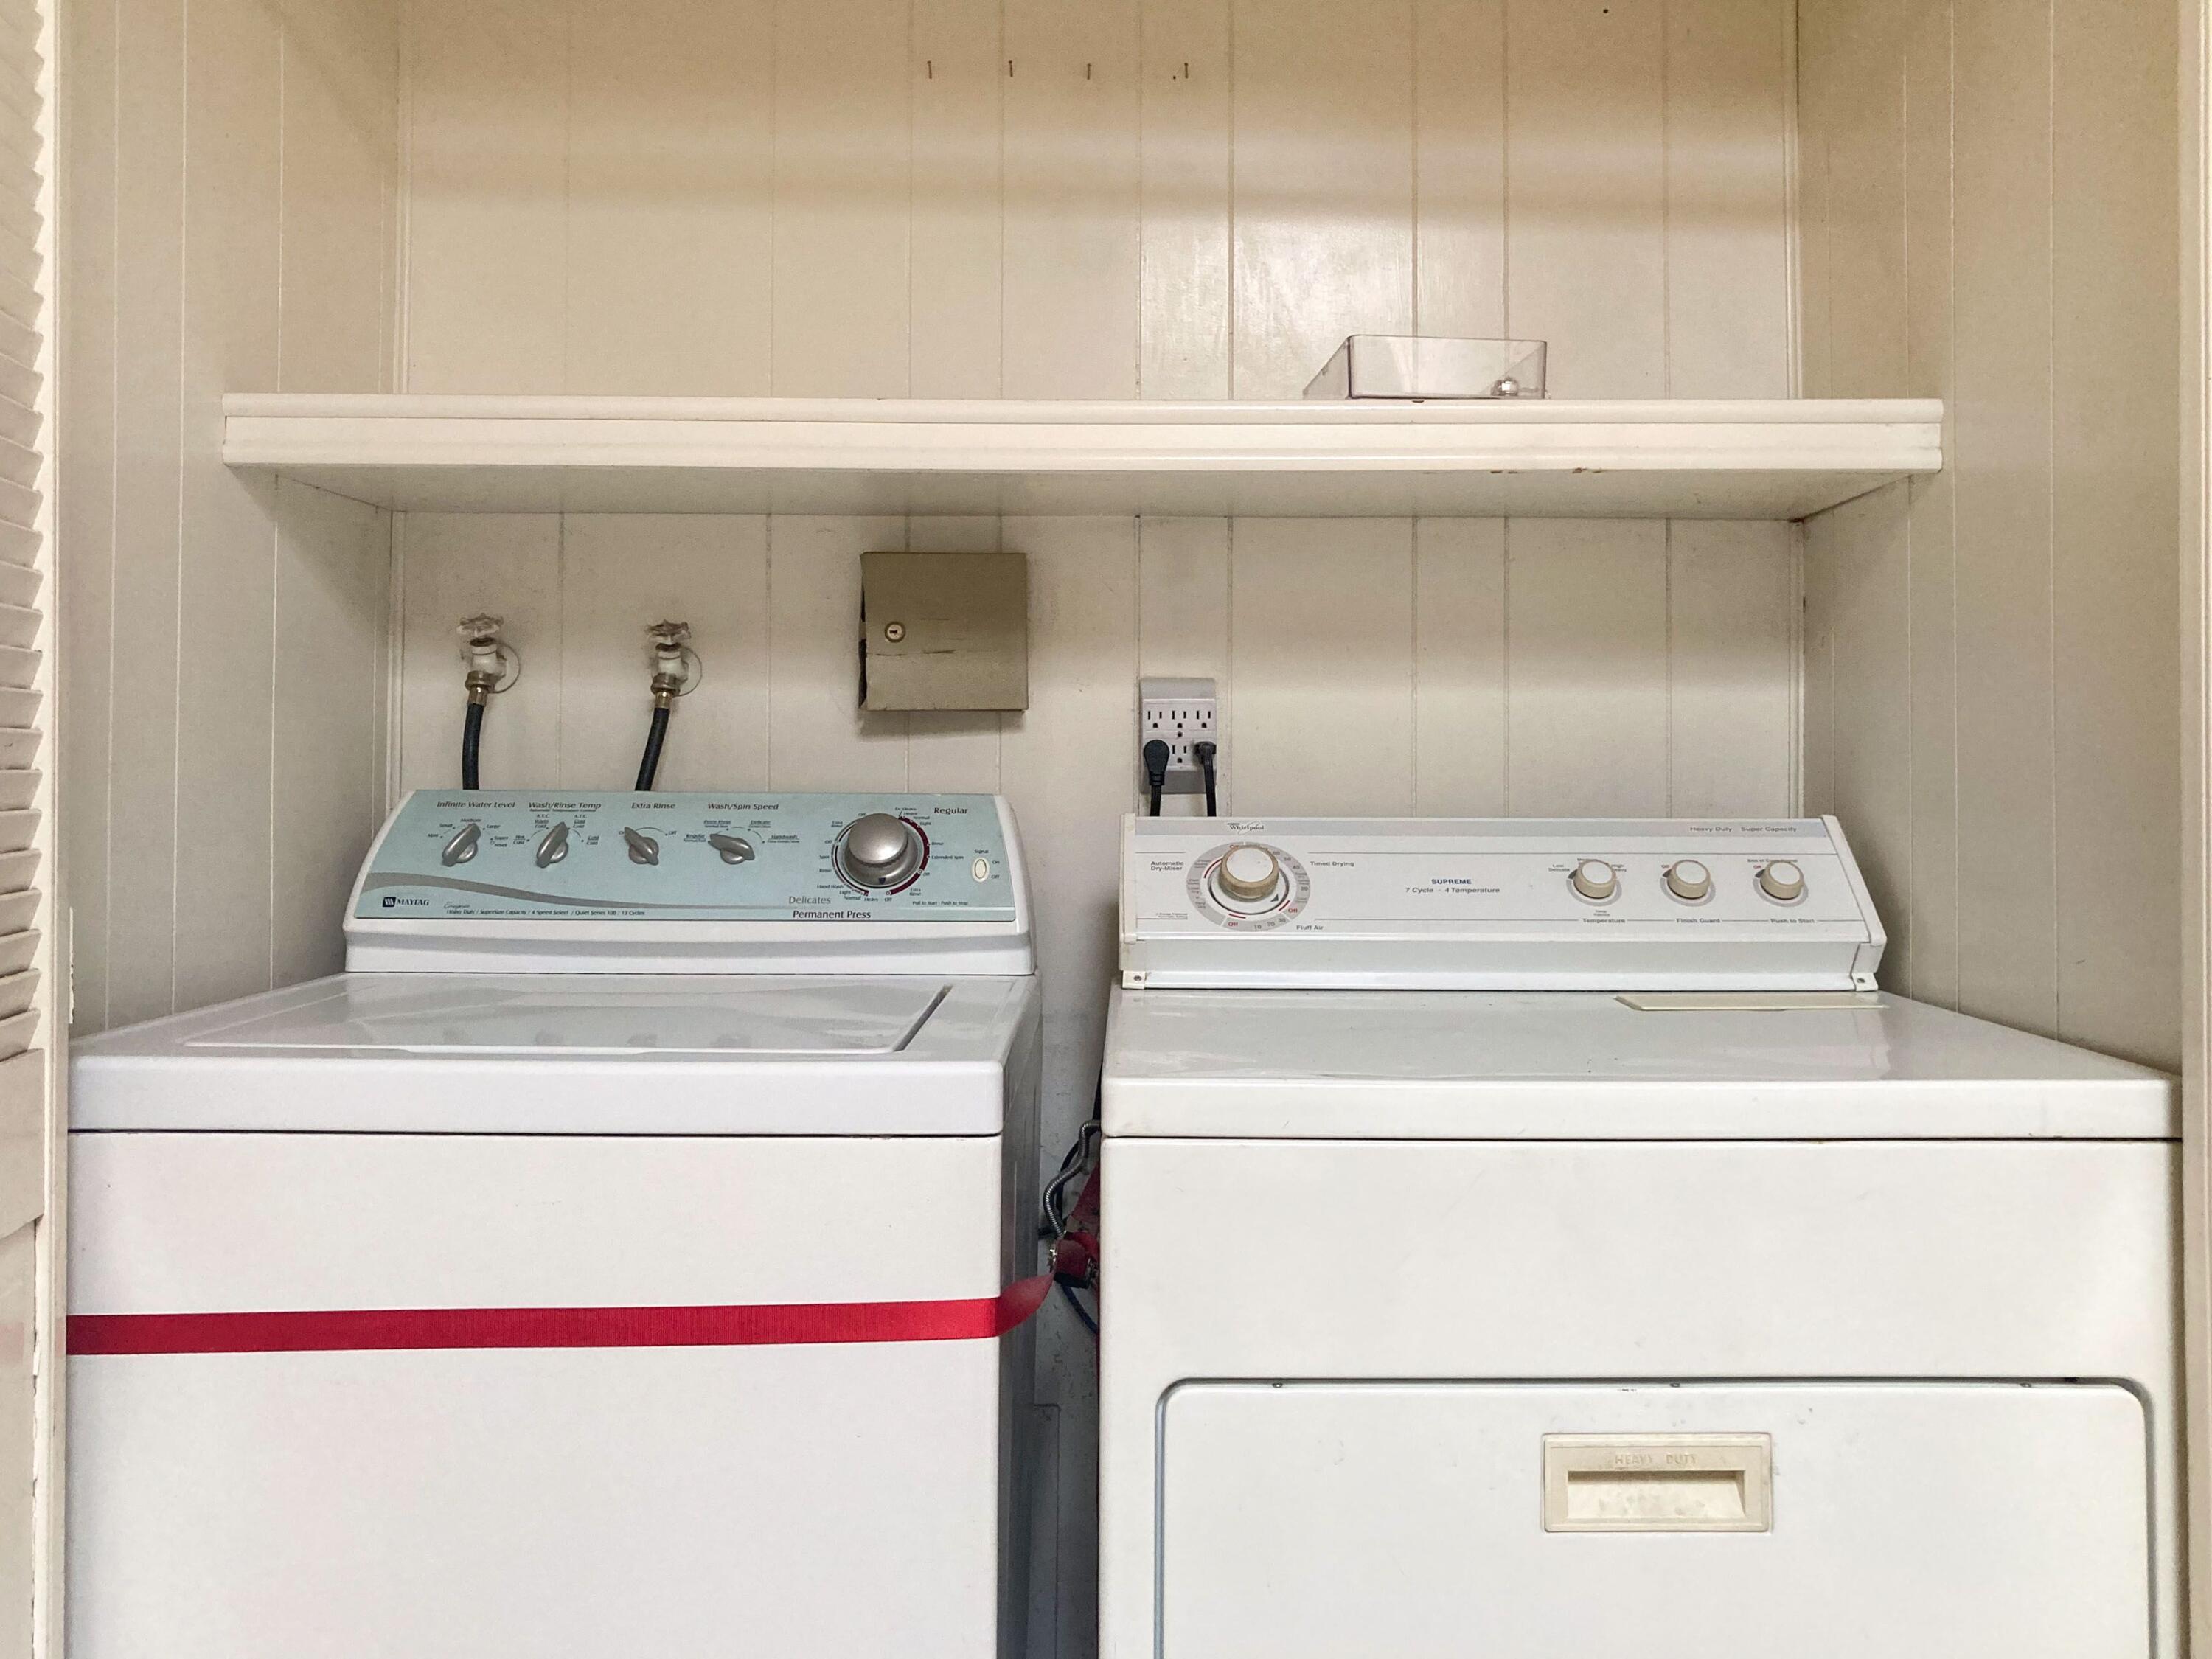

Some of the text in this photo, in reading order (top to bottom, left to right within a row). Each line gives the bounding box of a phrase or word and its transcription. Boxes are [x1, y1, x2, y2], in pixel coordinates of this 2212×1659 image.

[437, 801, 466, 809] Infinite
[579, 802, 602, 810] Temp
[753, 803, 779, 811] Speed
[1229, 824, 1264, 832] Whirlpool
[397, 898, 430, 906] MAYTAG
[788, 896, 832, 905] Delicates
[793, 910, 872, 919] Permanent Press
[1666, 1453, 1697, 1465] DUTY
